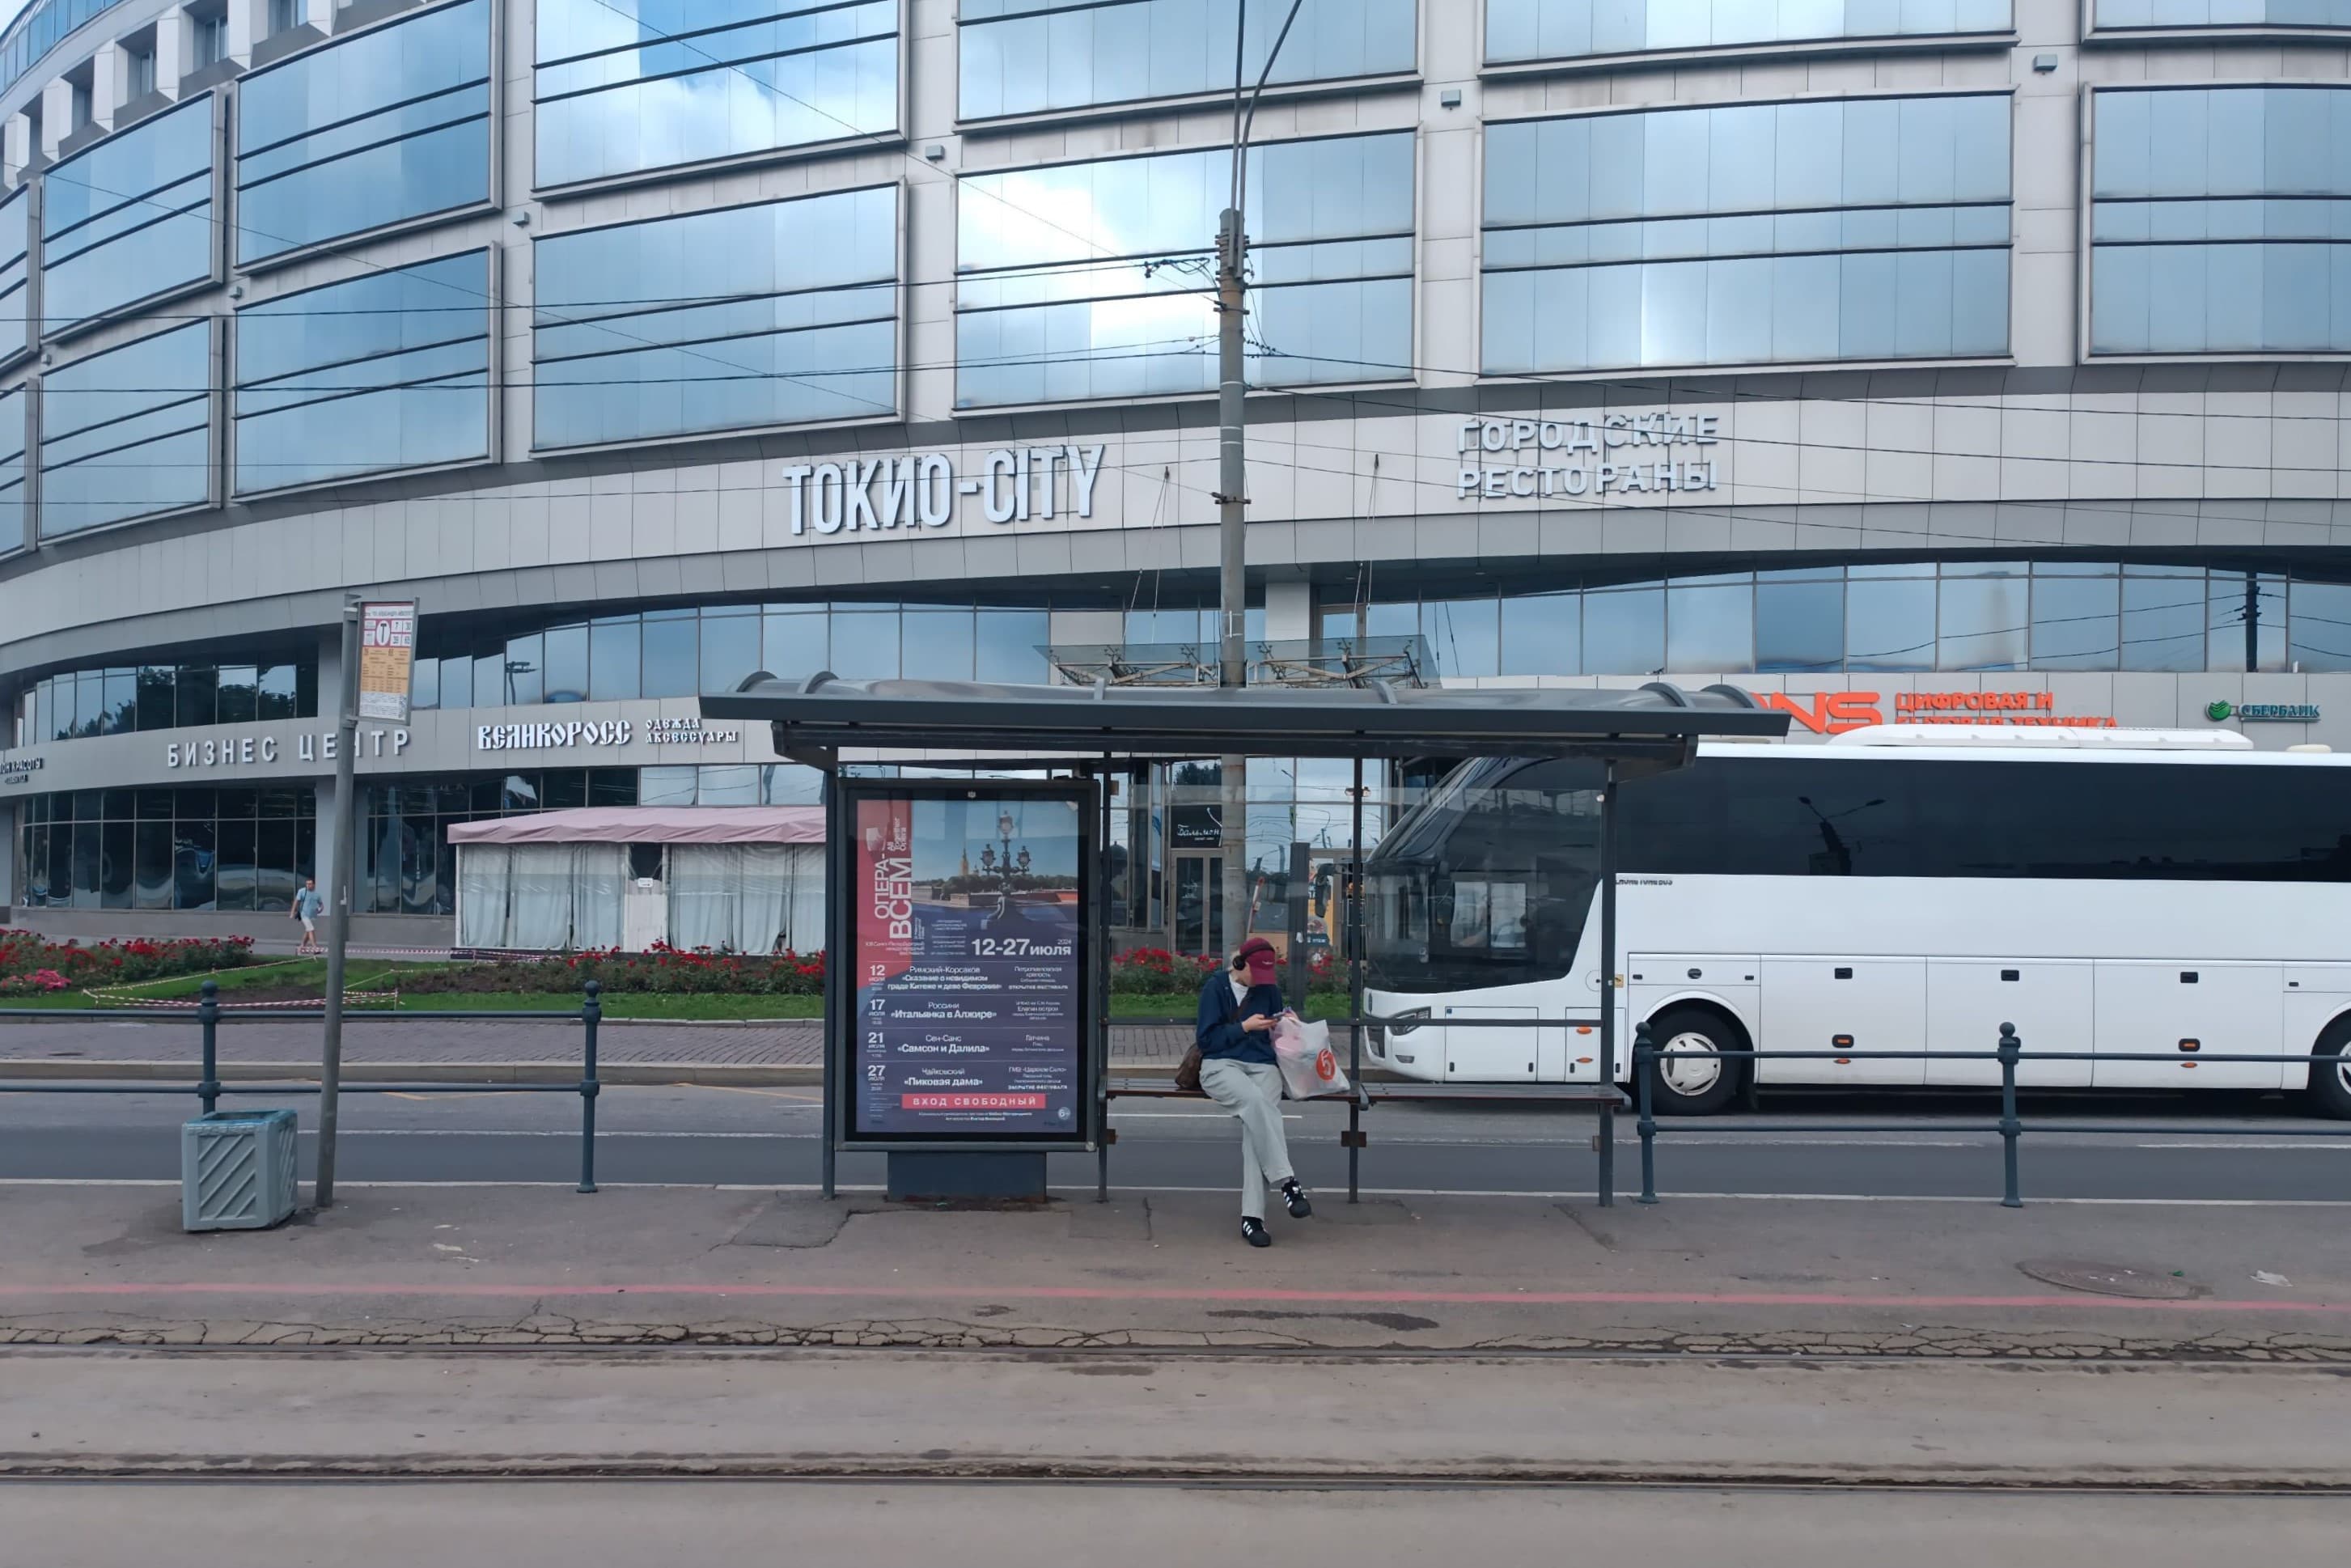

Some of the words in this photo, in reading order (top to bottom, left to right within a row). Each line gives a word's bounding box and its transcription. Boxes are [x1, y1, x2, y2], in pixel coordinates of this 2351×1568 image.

[1458, 413, 1718, 455] ГОРОДСКИЕ
[1458, 460, 1718, 499] РЕСТОРАНЫ
[782, 444, 1105, 536] ТОКИО-CITY
[1896, 693, 2028, 712] ЦИФРОВАЯ
[2035, 692, 2053, 710] И
[1750, 692, 1883, 734] NS
[2240, 704, 2320, 718] СБЕРБАНК
[646, 718, 701, 730] ОДЕЖДА
[477, 719, 633, 750] ВЕЛИКОРОСС
[646, 731, 738, 744] АКСЕССУАРЫ
[167, 735, 277, 768] БИЗНЕС
[1177, 824, 1219, 836] Бальмон
[889, 858, 913, 939] ВСЕМ
[972, 939, 1030, 956] 12-27
[1030, 946, 1071, 956] июля
[870, 964, 886, 976] 12
[909, 965, 981, 973] Римский-Корсаков
[870, 999, 886, 1011] 17
[928, 1002, 959, 1010] Россини
[891, 1010, 946, 1018] «Итальянка
[868, 1032, 883, 1044] 21
[925, 1034, 962, 1042] Сен-Санс
[897, 1044, 939, 1053] «Самсон
[867, 1065, 887, 1076] 27
[921, 1067, 965, 1075] Чайковский
[904, 1077, 951, 1086] «Пиковая
[951, 1079, 983, 1087] дама»
[913, 1098, 947, 1107] ВХОД
[954, 1096, 1036, 1107] СВОБОДНЫЙ
